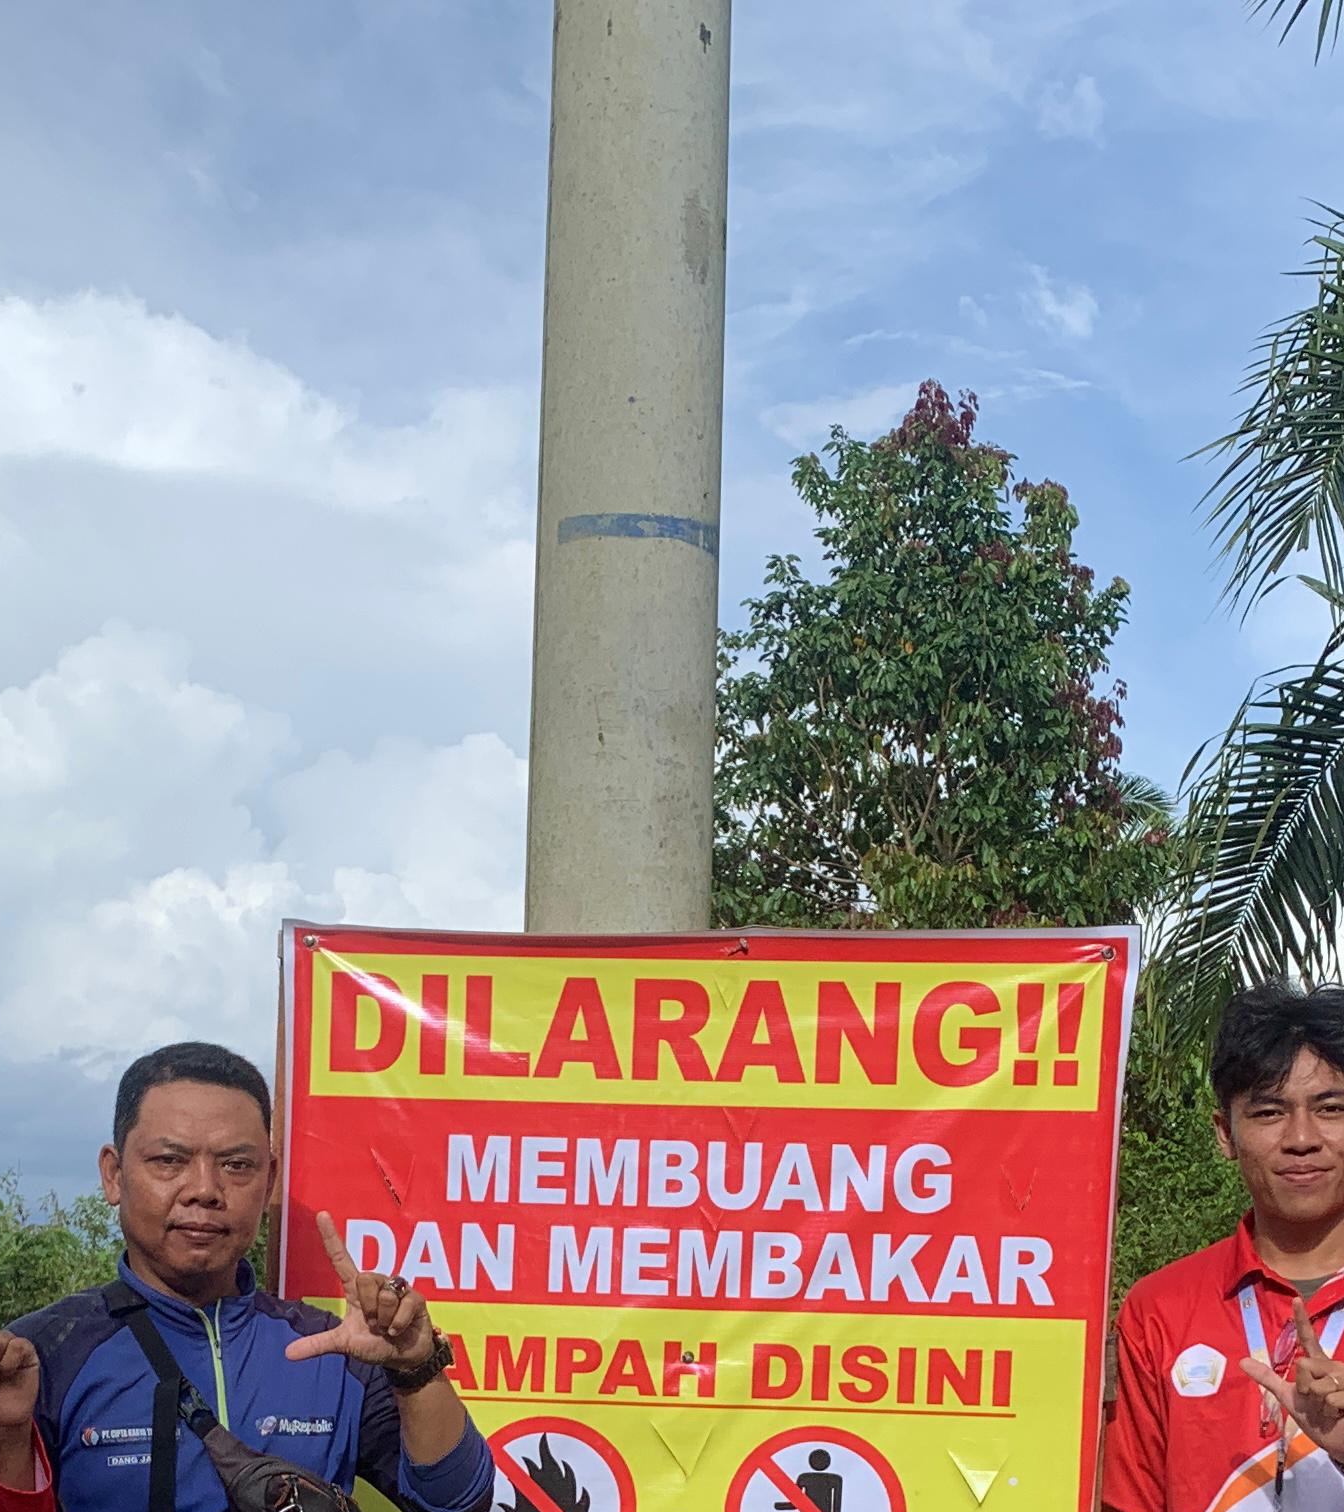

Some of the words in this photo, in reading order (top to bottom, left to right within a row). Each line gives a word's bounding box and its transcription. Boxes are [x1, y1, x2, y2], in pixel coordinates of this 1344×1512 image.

[329, 971, 1085, 1088] DILARANG!!
[446, 1134, 952, 1214] MEMBUANG
[344, 1219, 515, 1291] DAN
[548, 1225, 1055, 1306] MEMBAKAR
[444, 1330, 717, 1398] AMPAH
[751, 1343, 1012, 1407] DISINI
[279, 1418, 334, 1435] MyRepublic
